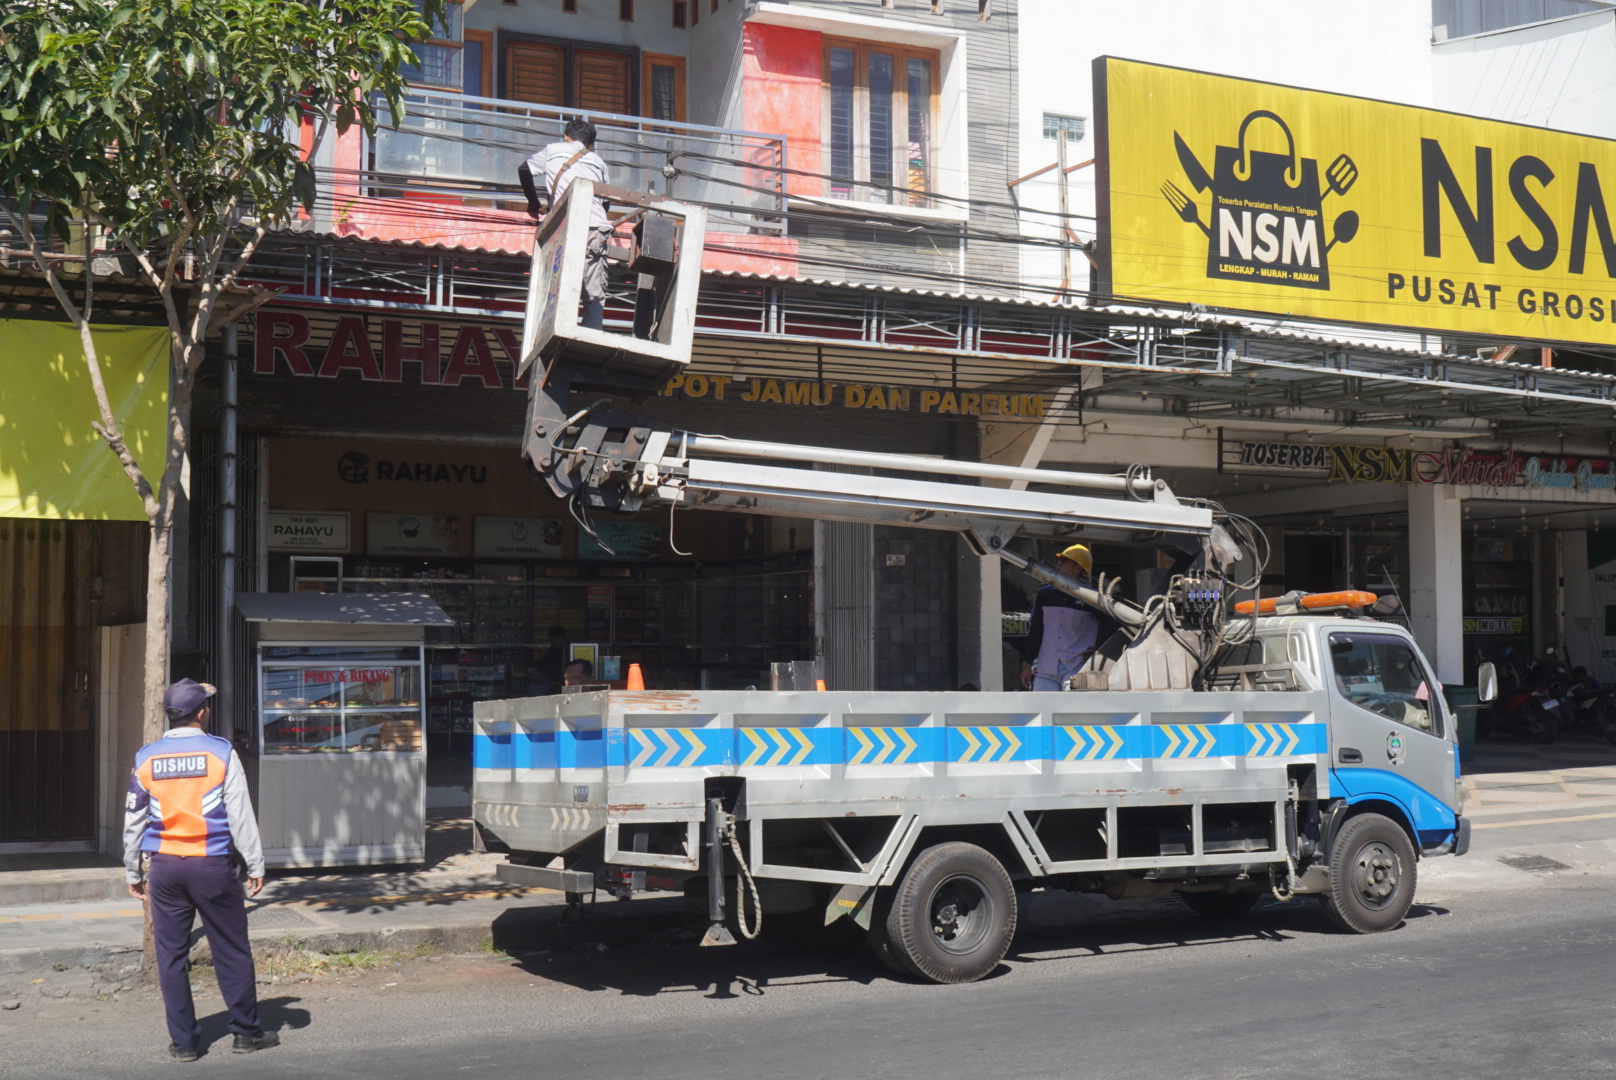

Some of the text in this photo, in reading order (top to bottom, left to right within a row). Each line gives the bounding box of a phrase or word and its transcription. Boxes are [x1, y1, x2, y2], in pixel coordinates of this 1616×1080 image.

[1217, 195, 1318, 217] Toserba Peralatan Rumah Tangga
[1219, 208, 1320, 268] NSM
[1219, 264, 1255, 275] LENGKAP
[1260, 268, 1288, 279] MURAH
[1293, 272, 1319, 282] RAMAH
[1387, 272, 1502, 310] PUSAT
[254, 310, 528, 391] RAHAY
[740, 378, 833, 406] JAMU
[845, 384, 911, 412] DAN
[920, 390, 1044, 418] PARFUM
[377, 461, 487, 484] RAHAYU
[1242, 441, 1327, 468] TOSERBA
[1329, 444, 1414, 484] NSM
[1414, 445, 1520, 486] Murah
[274, 525, 333, 536] RAHAYU
[304, 670, 335, 683] PUKIS
[338, 670, 347, 682] &
[153, 756, 206, 773] DISHUB
